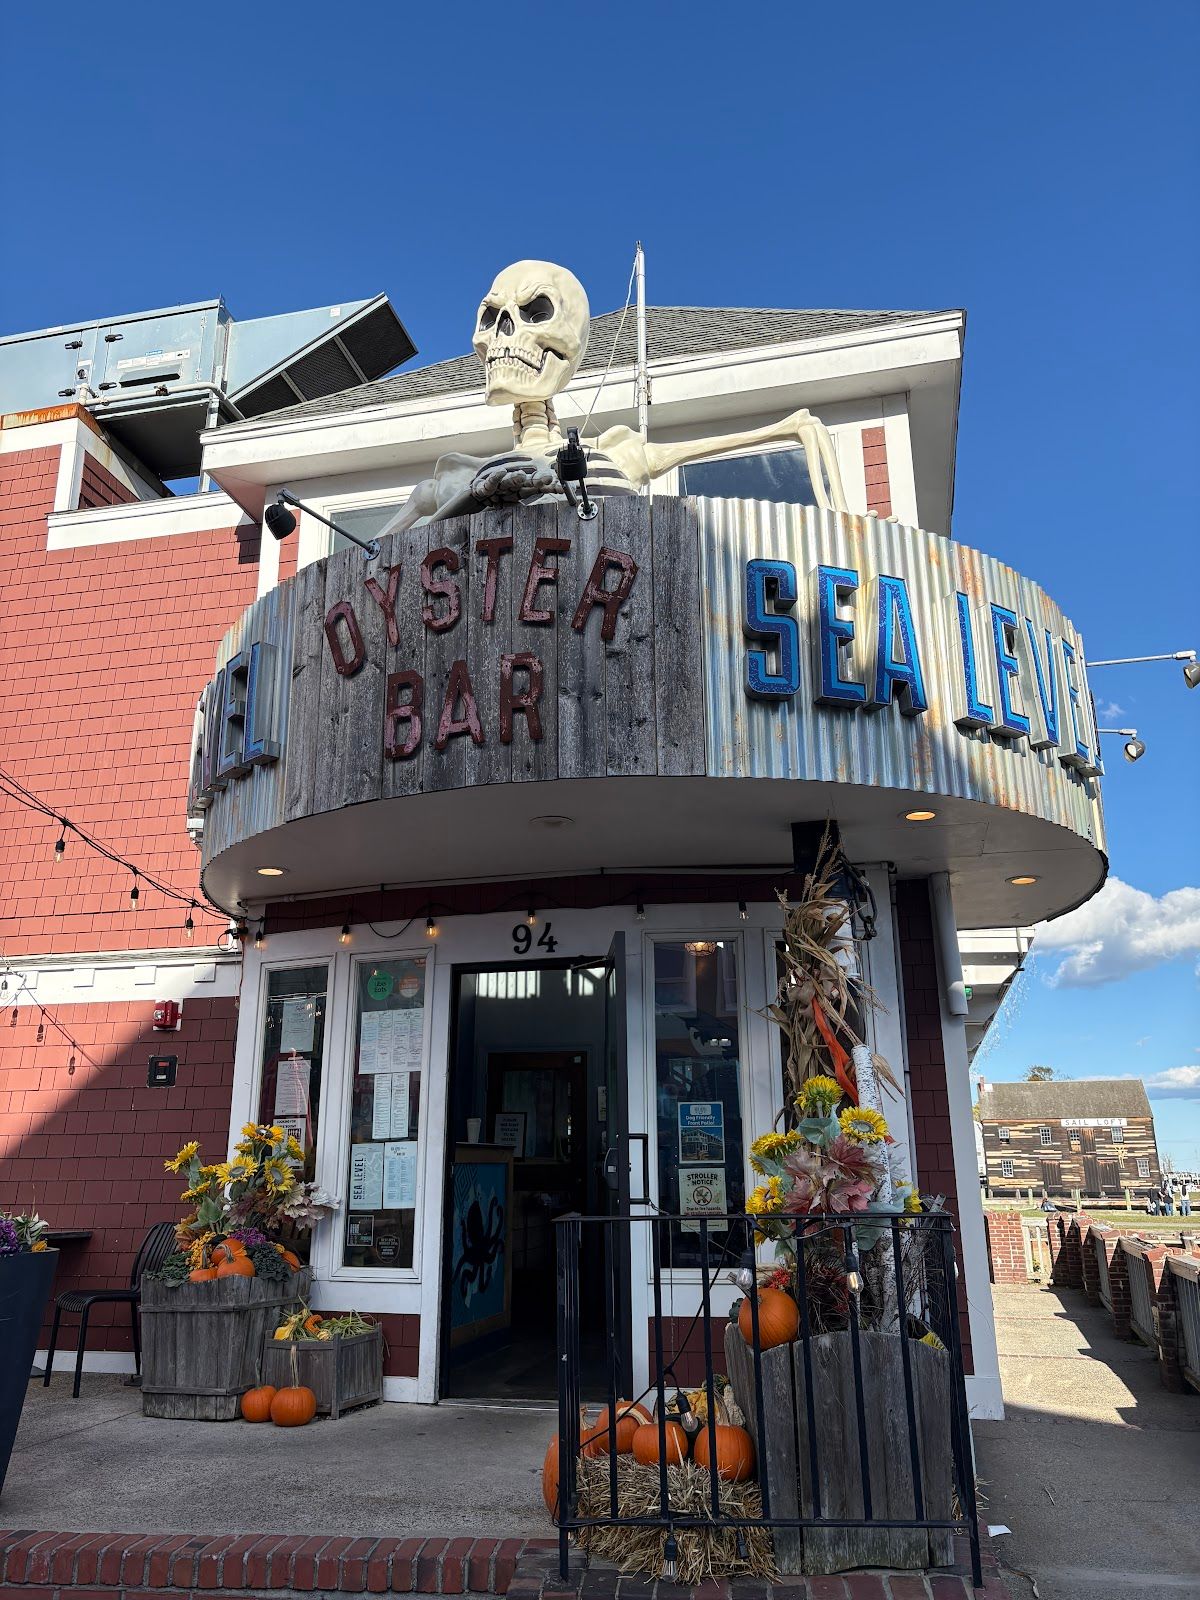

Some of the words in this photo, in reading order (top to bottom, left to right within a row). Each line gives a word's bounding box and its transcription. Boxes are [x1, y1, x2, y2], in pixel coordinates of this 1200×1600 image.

[324, 536, 639, 677] OYSTER
[744, 558, 929, 717] SEA
[384, 651, 543, 760] BAR
[511, 921, 559, 955] 94
[1096, 1118, 1123, 1126] LOFT
[354, 1157, 364, 1181] LEVEL
[686, 1173, 718, 1181] STROLLER
[353, 1184, 363, 1200] SEA
